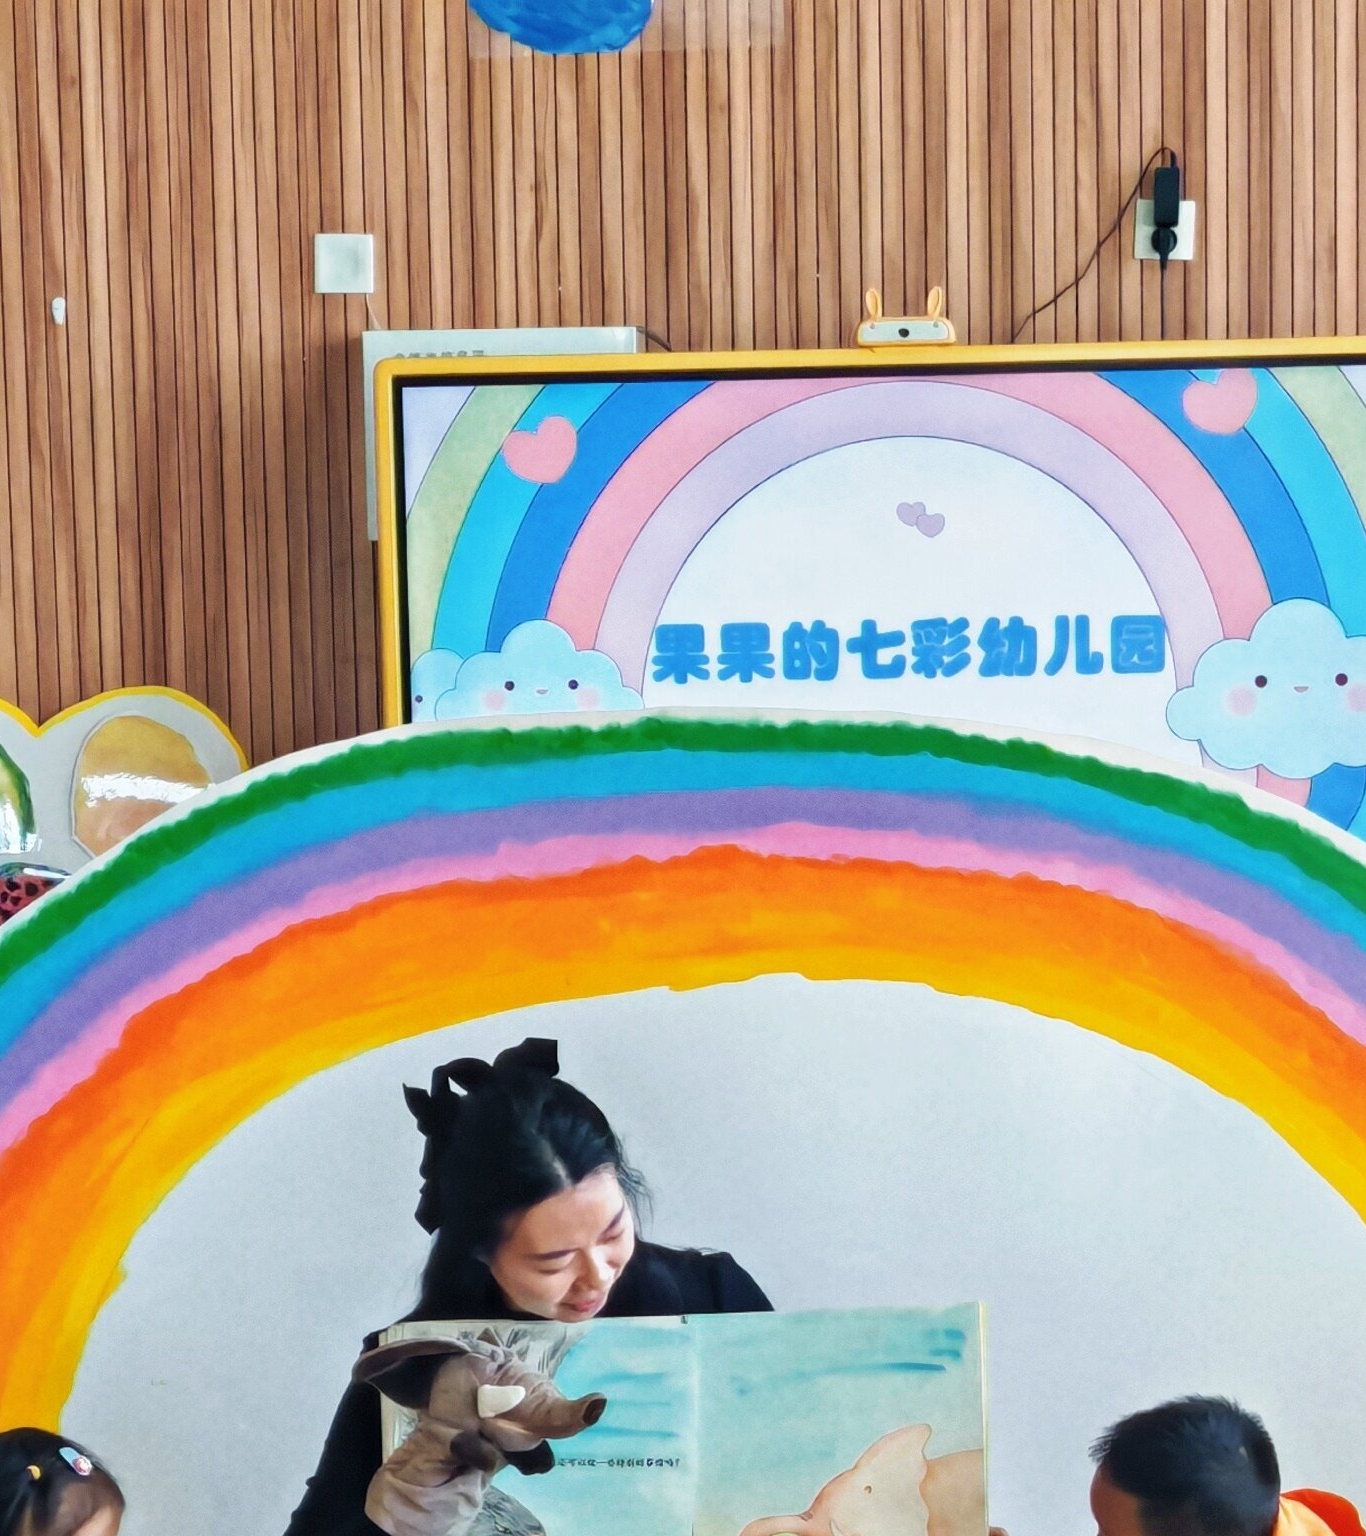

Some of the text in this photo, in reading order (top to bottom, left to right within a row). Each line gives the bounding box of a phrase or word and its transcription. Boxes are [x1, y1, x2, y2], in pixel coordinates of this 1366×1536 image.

[651, 614, 1166, 684] 果果的七彩幼儿园
